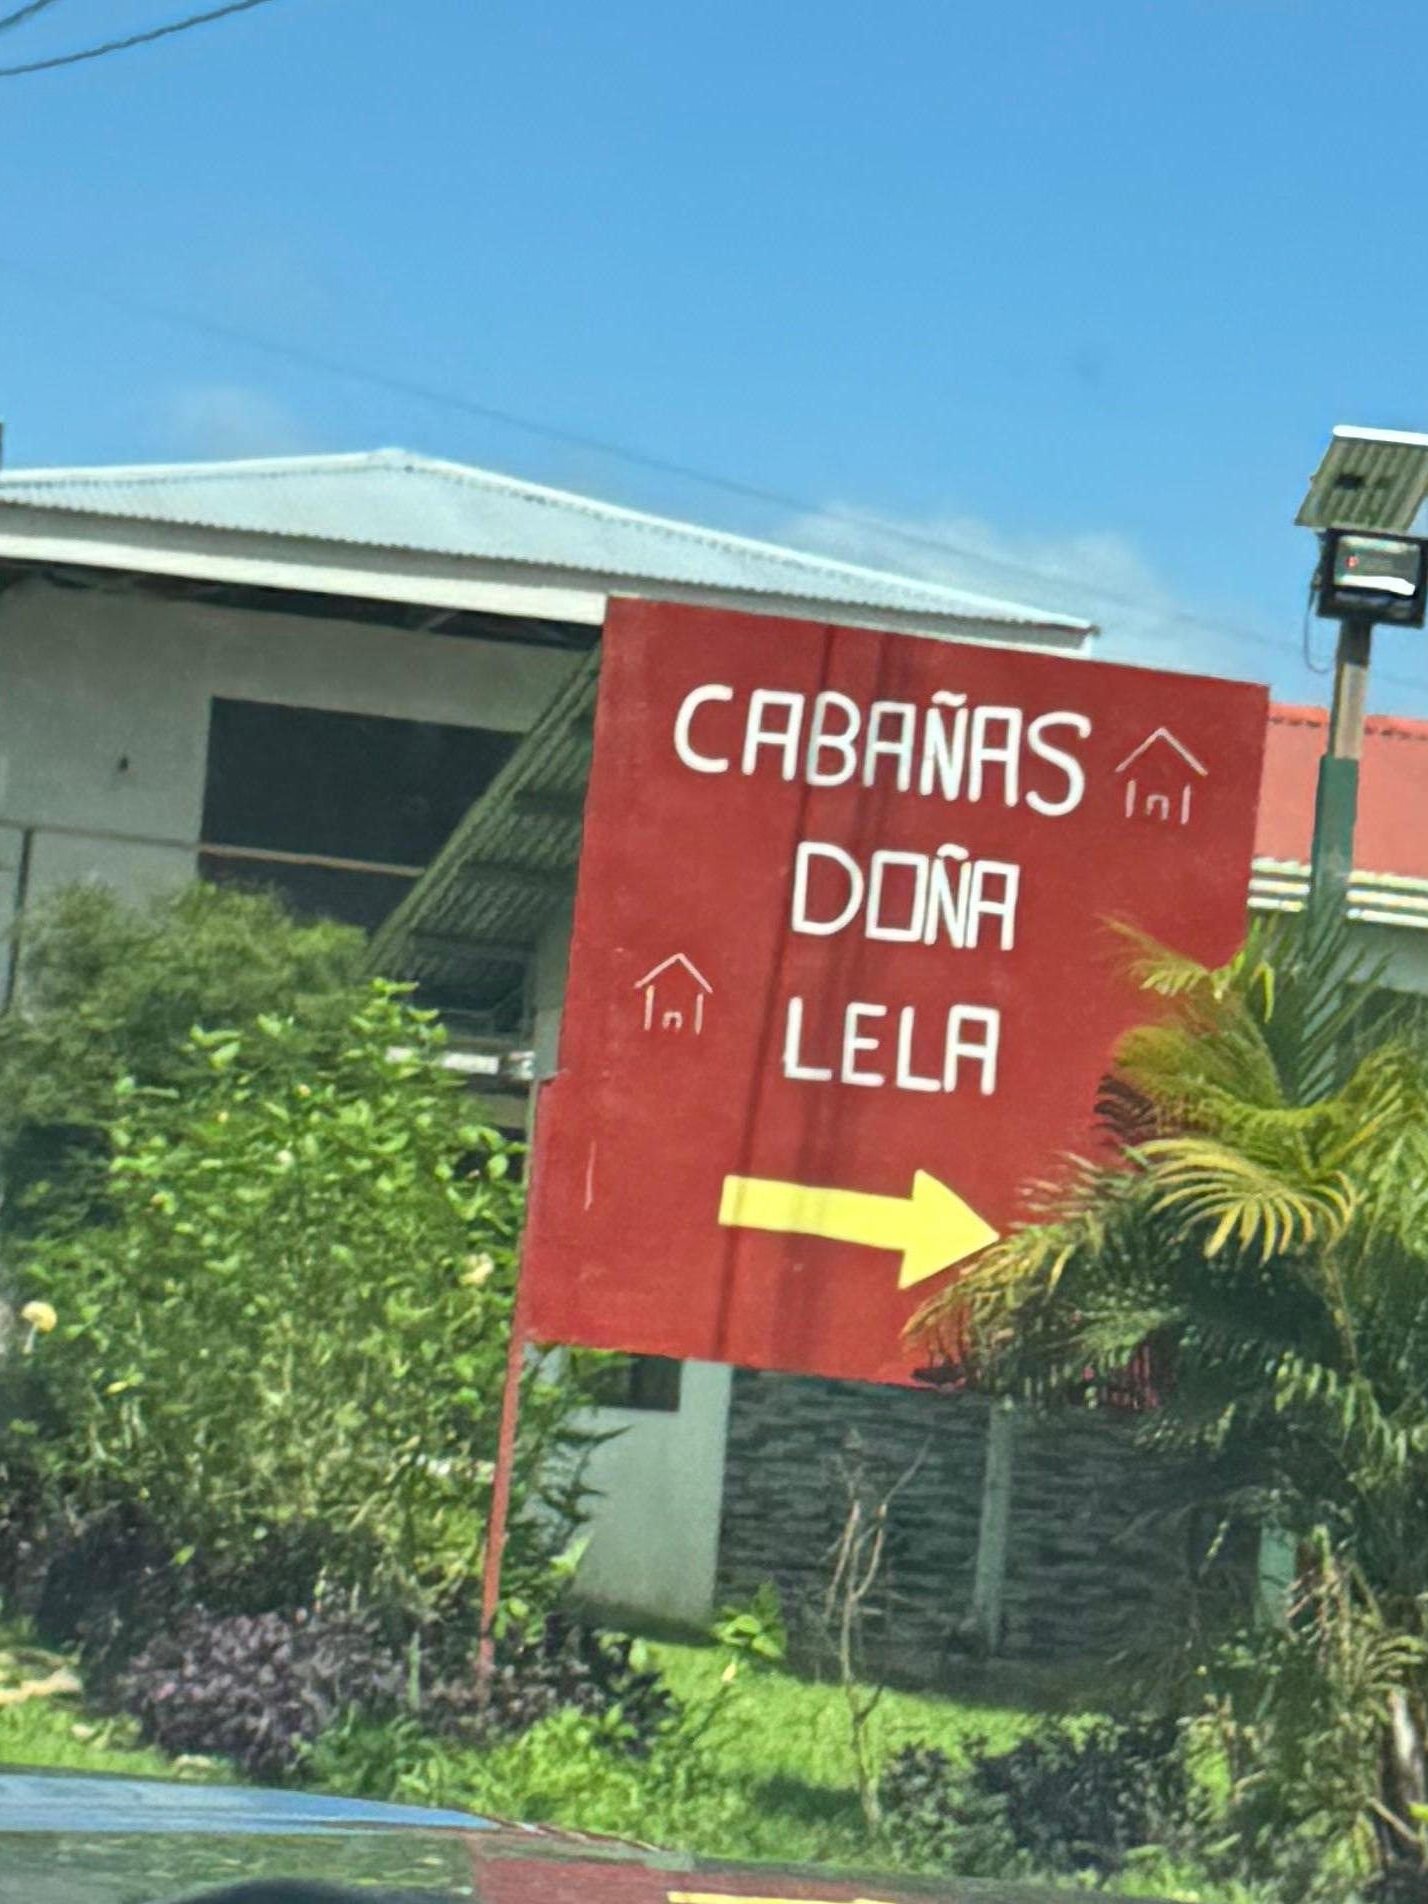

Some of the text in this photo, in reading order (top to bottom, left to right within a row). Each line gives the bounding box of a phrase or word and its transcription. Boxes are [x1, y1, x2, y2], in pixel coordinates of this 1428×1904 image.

[673, 682, 1092, 817] CABAÑAS
[791, 840, 1021, 951] DOÑA
[781, 996, 1001, 1096] LELA
